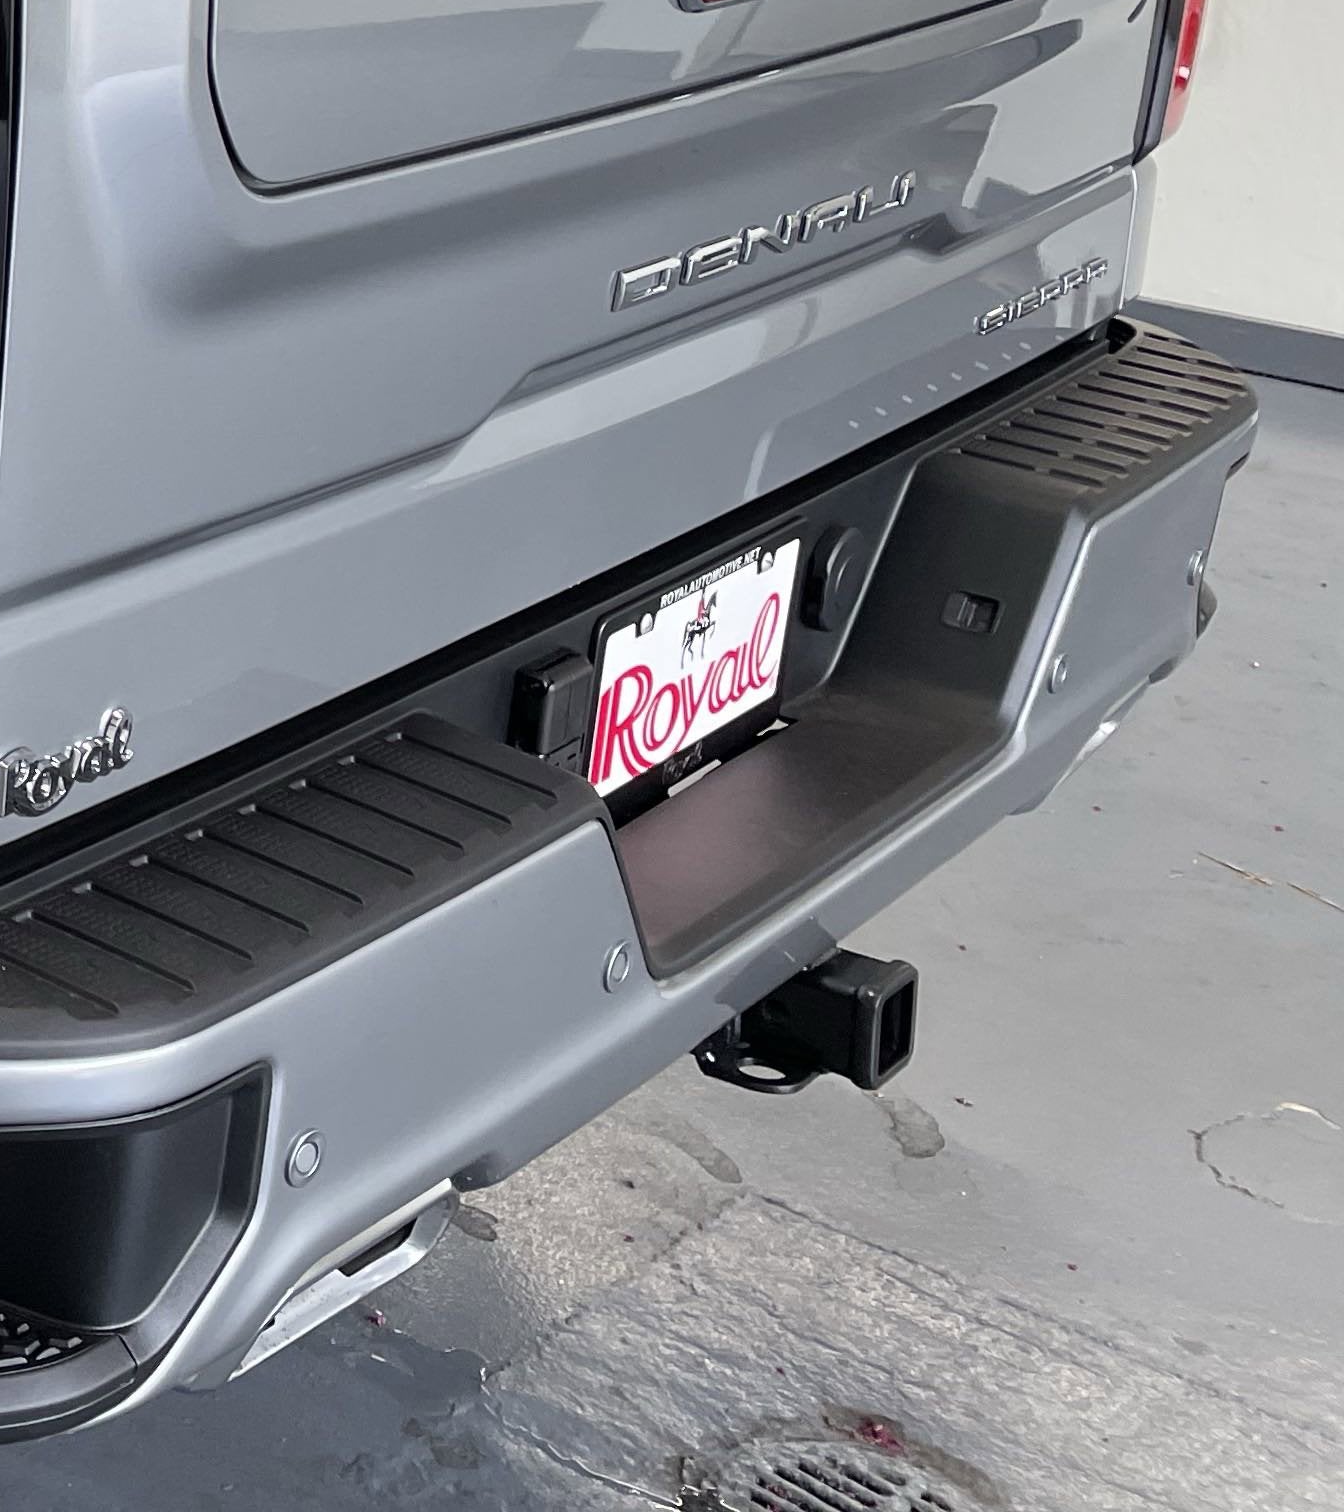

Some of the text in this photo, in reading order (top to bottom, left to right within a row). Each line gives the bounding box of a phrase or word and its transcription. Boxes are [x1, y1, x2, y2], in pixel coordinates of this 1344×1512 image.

[611, 170, 917, 312] DENALI
[974, 257, 1109, 336] SIERRA
[660, 546, 762, 609] ROYALAUTOMOTIVE.NET
[587, 591, 781, 786] Royal
